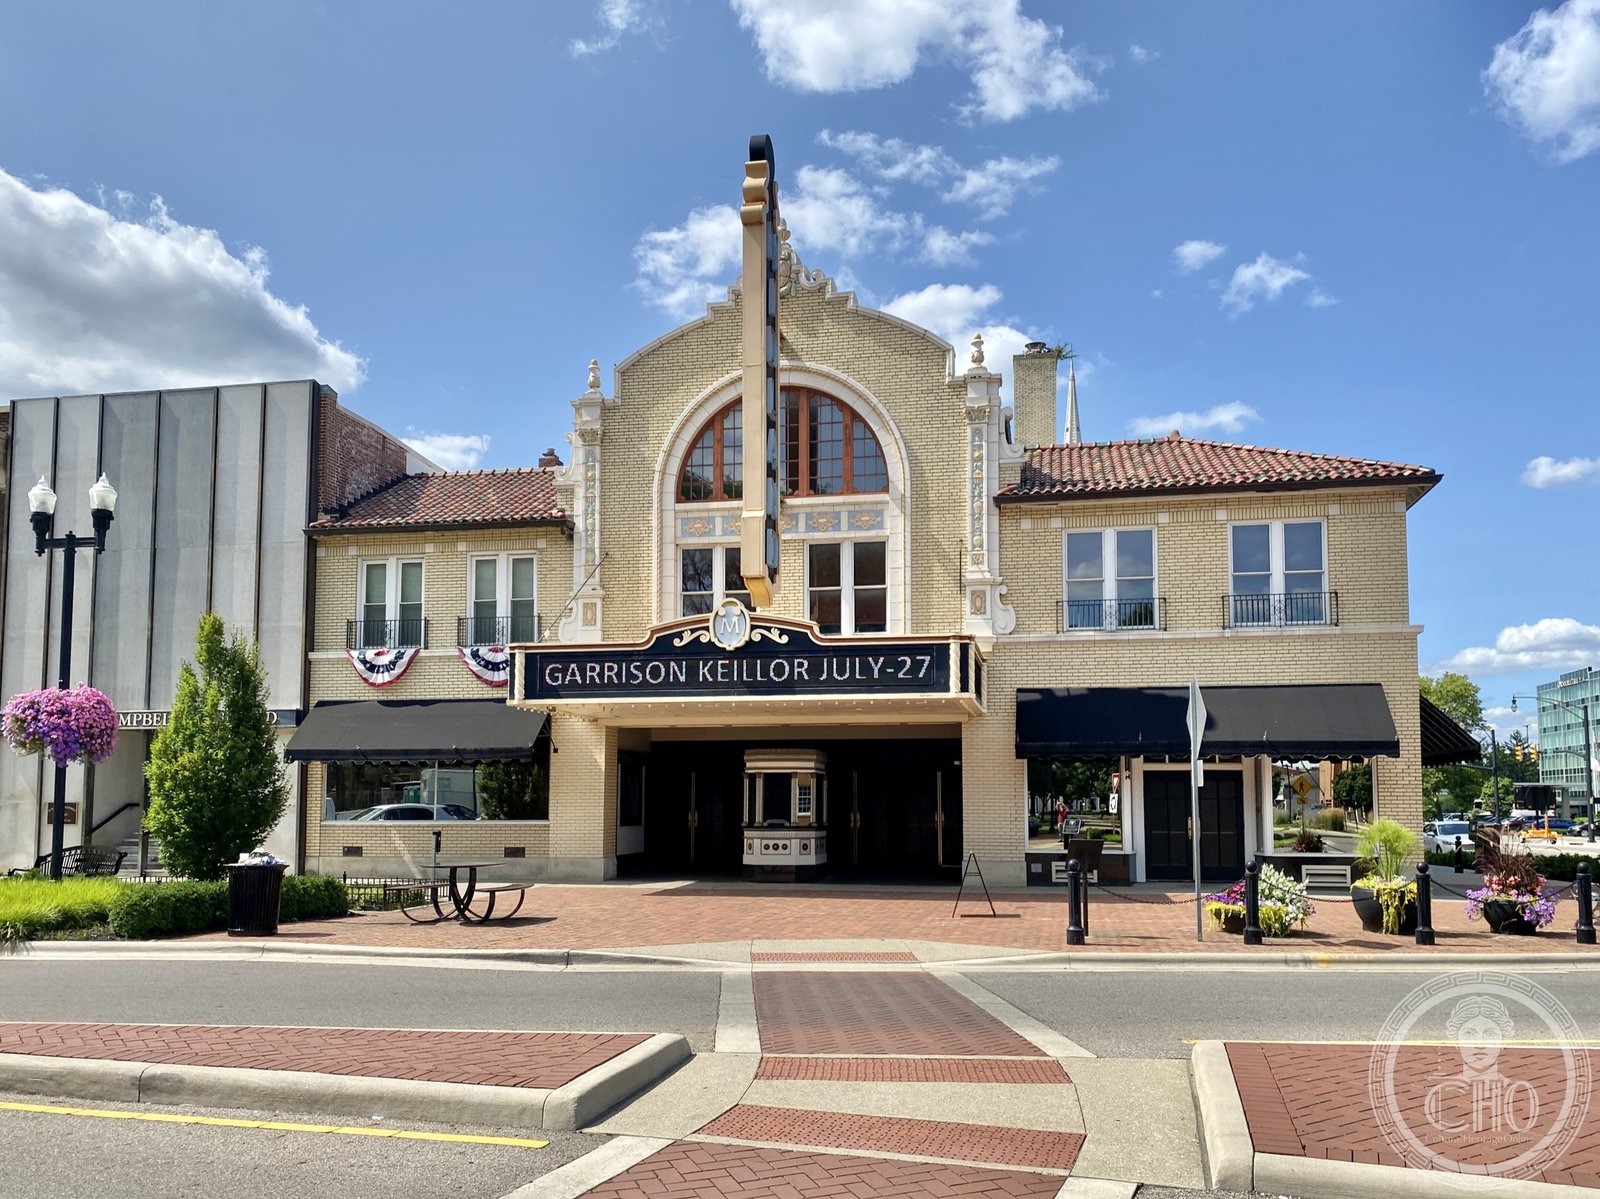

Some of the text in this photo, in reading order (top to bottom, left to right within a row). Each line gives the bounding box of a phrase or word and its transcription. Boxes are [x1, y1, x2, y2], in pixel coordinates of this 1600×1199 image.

[719, 617, 741, 635] M
[545, 655, 932, 686] GARRISON KEILLOR JULY-27
